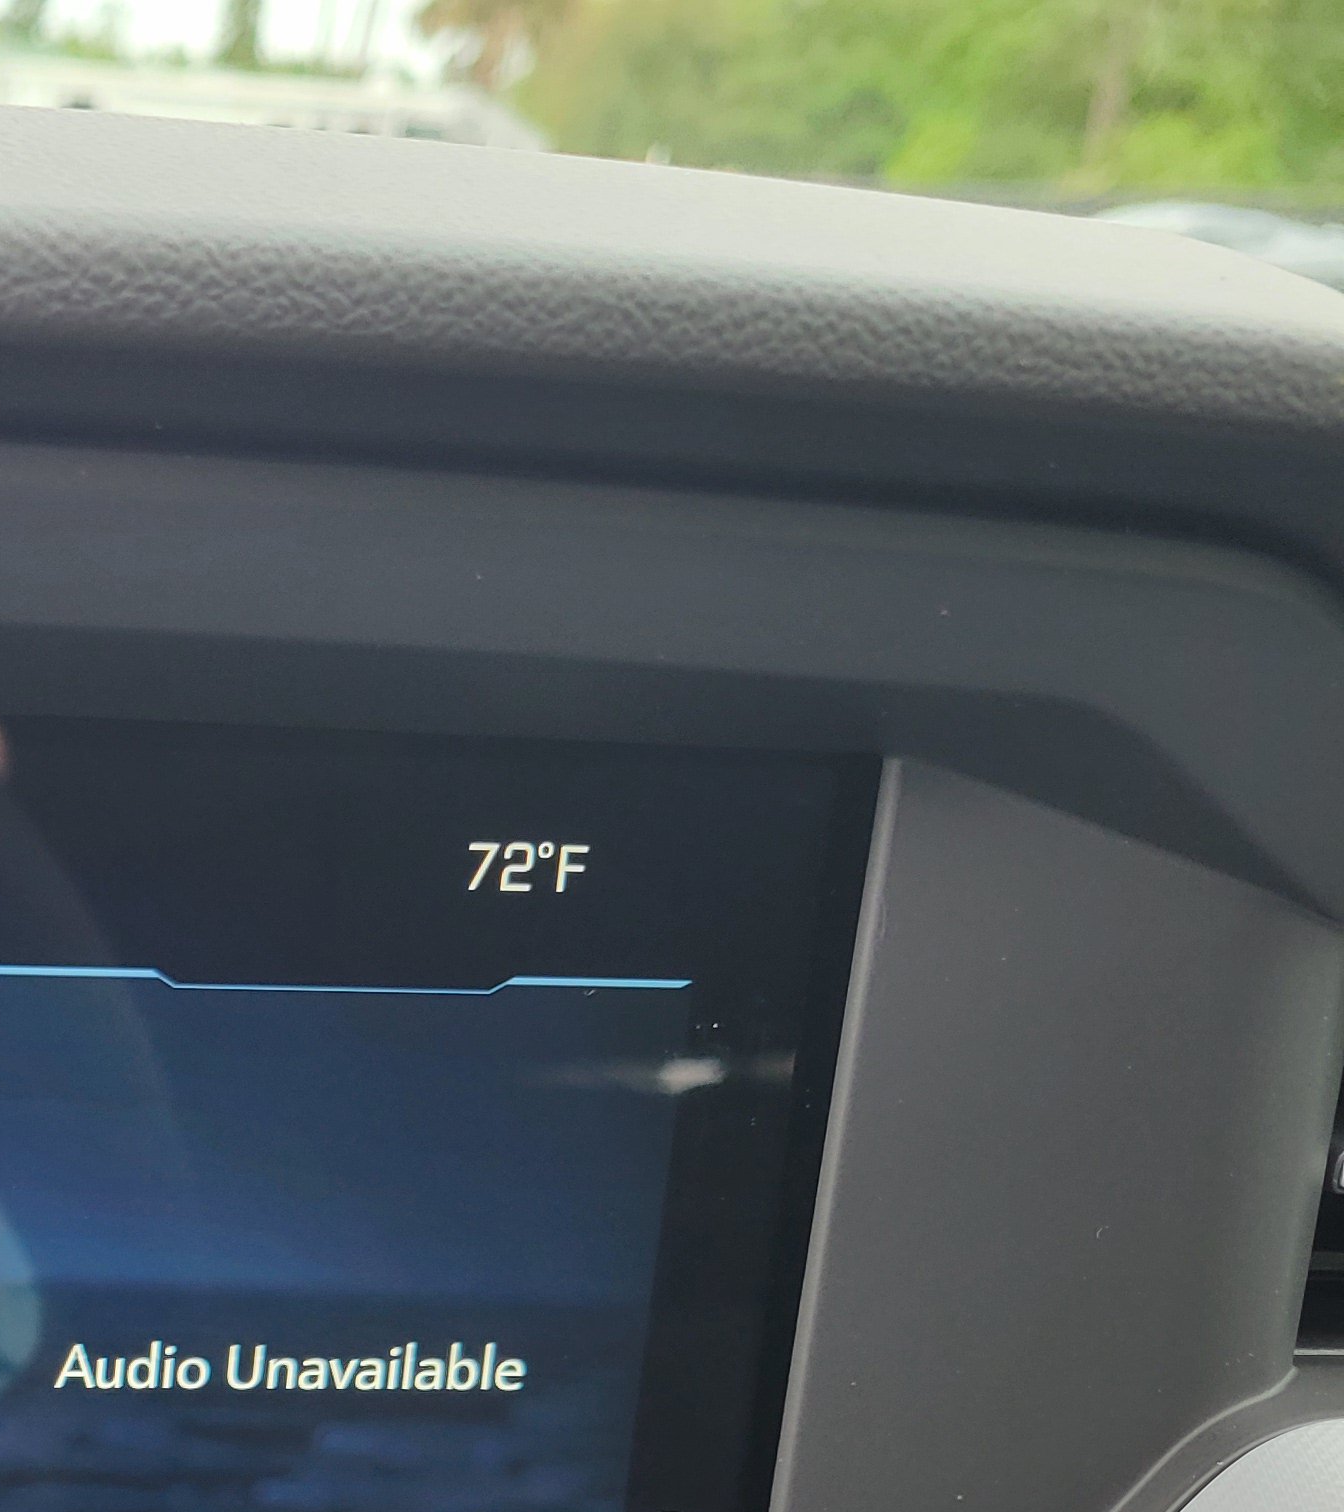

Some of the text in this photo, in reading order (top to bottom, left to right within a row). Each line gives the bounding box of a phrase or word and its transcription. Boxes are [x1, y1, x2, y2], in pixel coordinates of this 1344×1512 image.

[468, 841, 590, 893] 72°F
[53, 1340, 526, 1391] Audio Unavailable
